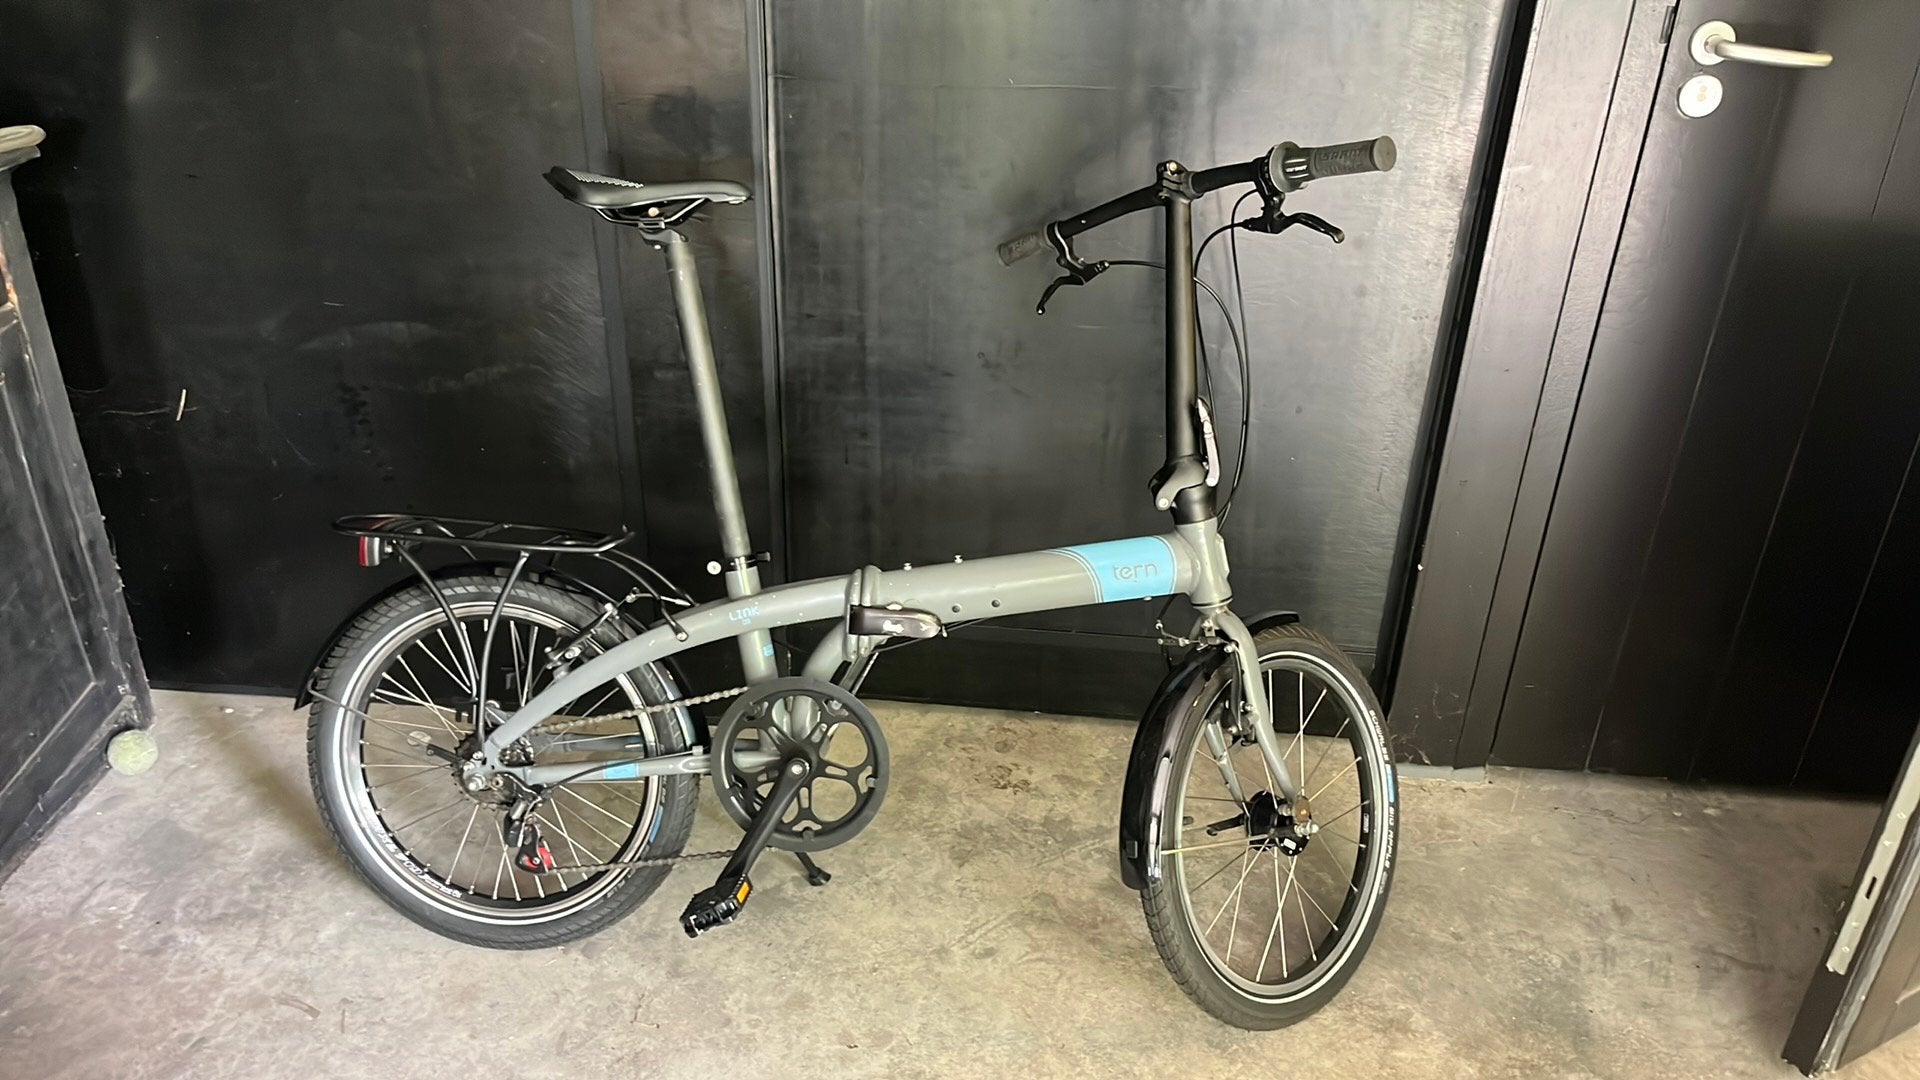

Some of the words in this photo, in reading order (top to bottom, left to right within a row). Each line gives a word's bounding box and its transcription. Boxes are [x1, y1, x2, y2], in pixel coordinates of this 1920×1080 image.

[1112, 563, 1158, 581] tern
[1368, 709, 1391, 761] SCHWALBE
[1384, 829, 1394, 869] APPLE
